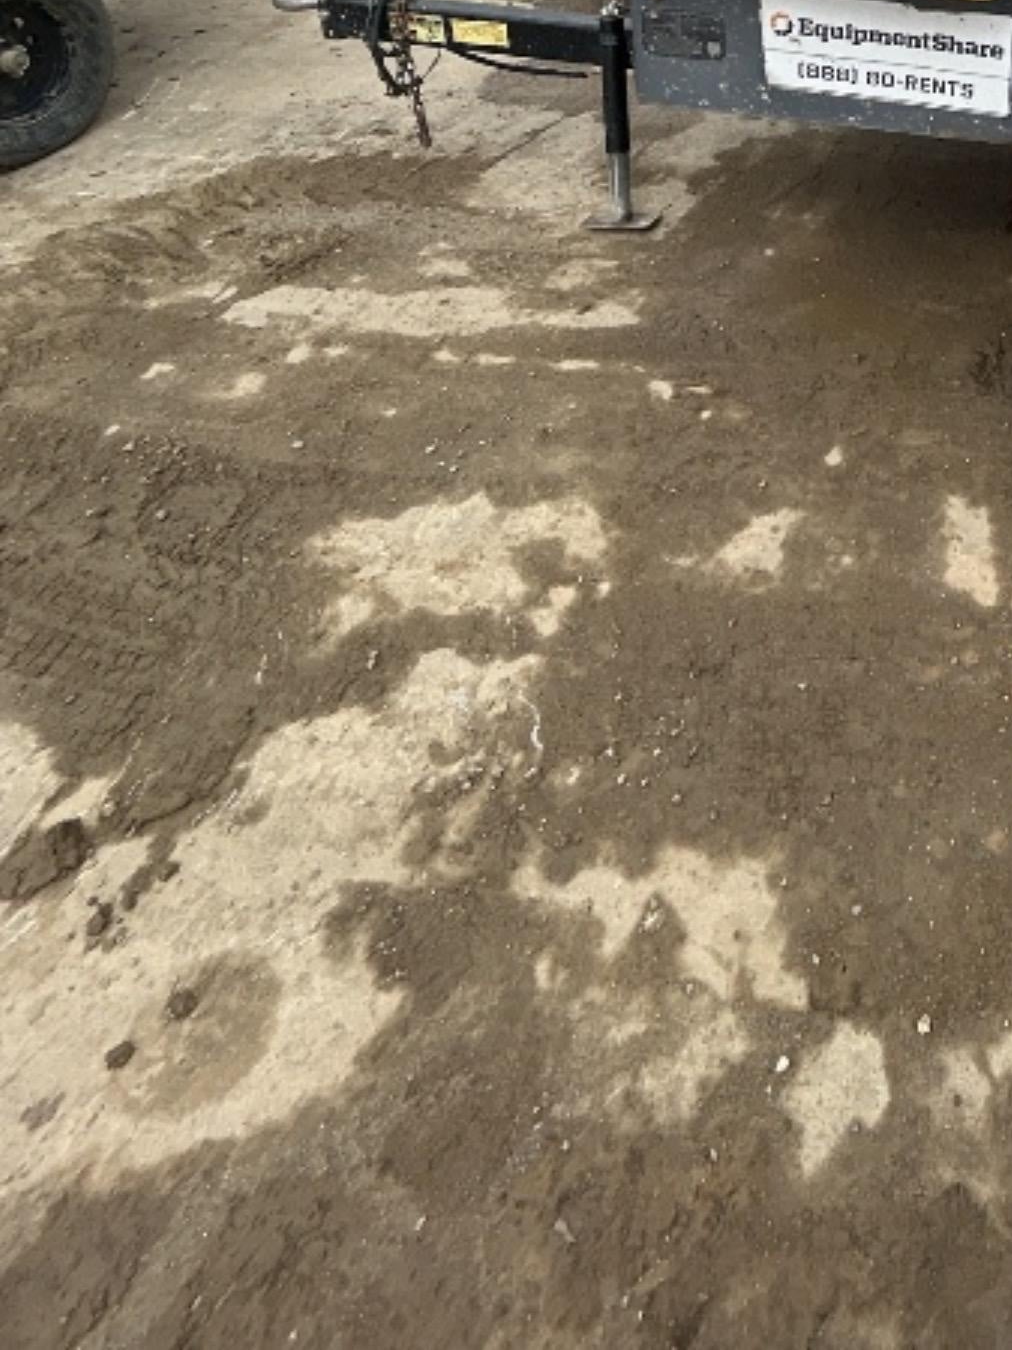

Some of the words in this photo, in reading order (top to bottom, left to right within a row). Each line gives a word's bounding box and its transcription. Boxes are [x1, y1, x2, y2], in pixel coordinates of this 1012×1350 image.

[798, 17, 1005, 60] EquipmentShare
[797, 62, 859, 85] (888)
[866, 71, 974, 99] 80-RENTS
